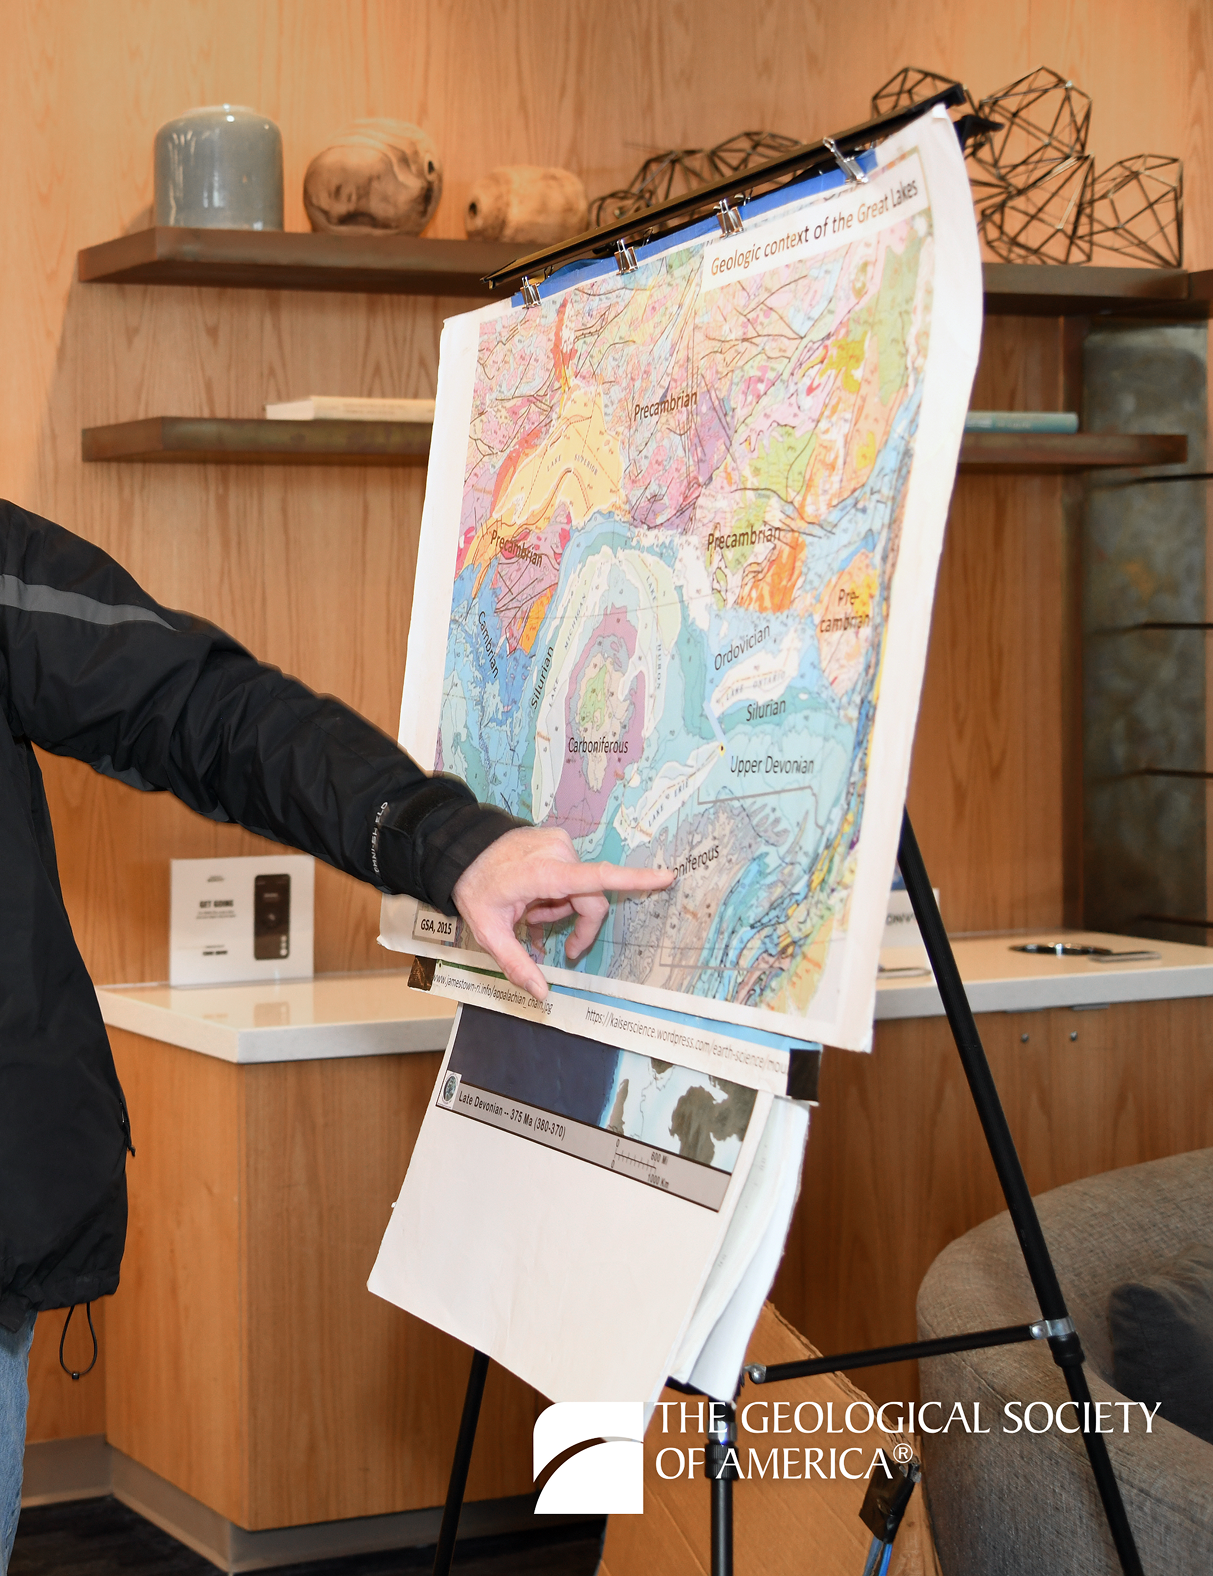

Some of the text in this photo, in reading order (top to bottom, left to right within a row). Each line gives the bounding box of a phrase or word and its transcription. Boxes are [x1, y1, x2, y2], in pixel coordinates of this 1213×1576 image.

[711, 178, 919, 276] Geologic context of the Great Lakes
[634, 390, 698, 421] Precambrian
[547, 453, 599, 476] LAKE SUPERIOR
[490, 529, 543, 567] Precambrian
[707, 525, 782, 551] Precambrian
[646, 576, 657, 601] LAKE
[838, 588, 859, 606] Pre-
[819, 613, 869, 633] cambrian
[478, 611, 499, 679] Cambrian
[714, 625, 770, 671] Ordovician
[530, 646, 554, 709] Silurian
[746, 699, 786, 722] Silurian
[568, 737, 629, 754] Carboniferous
[730, 755, 815, 777] Upper Devonian
[648, 805, 664, 827] LAKE
[371, 801, 388, 873] OMNI-SHELD
[671, 845, 720, 881] oniferous
[420, 918, 452, 935] GSA, 2015
[458, 1091, 473, 1106] Late
[474, 1096, 503, 1116] Devonian
[510, 1108, 522, 1123] 375
[524, 1112, 533, 1127] Ma
[533, 1117, 566, 1141] (380-370)
